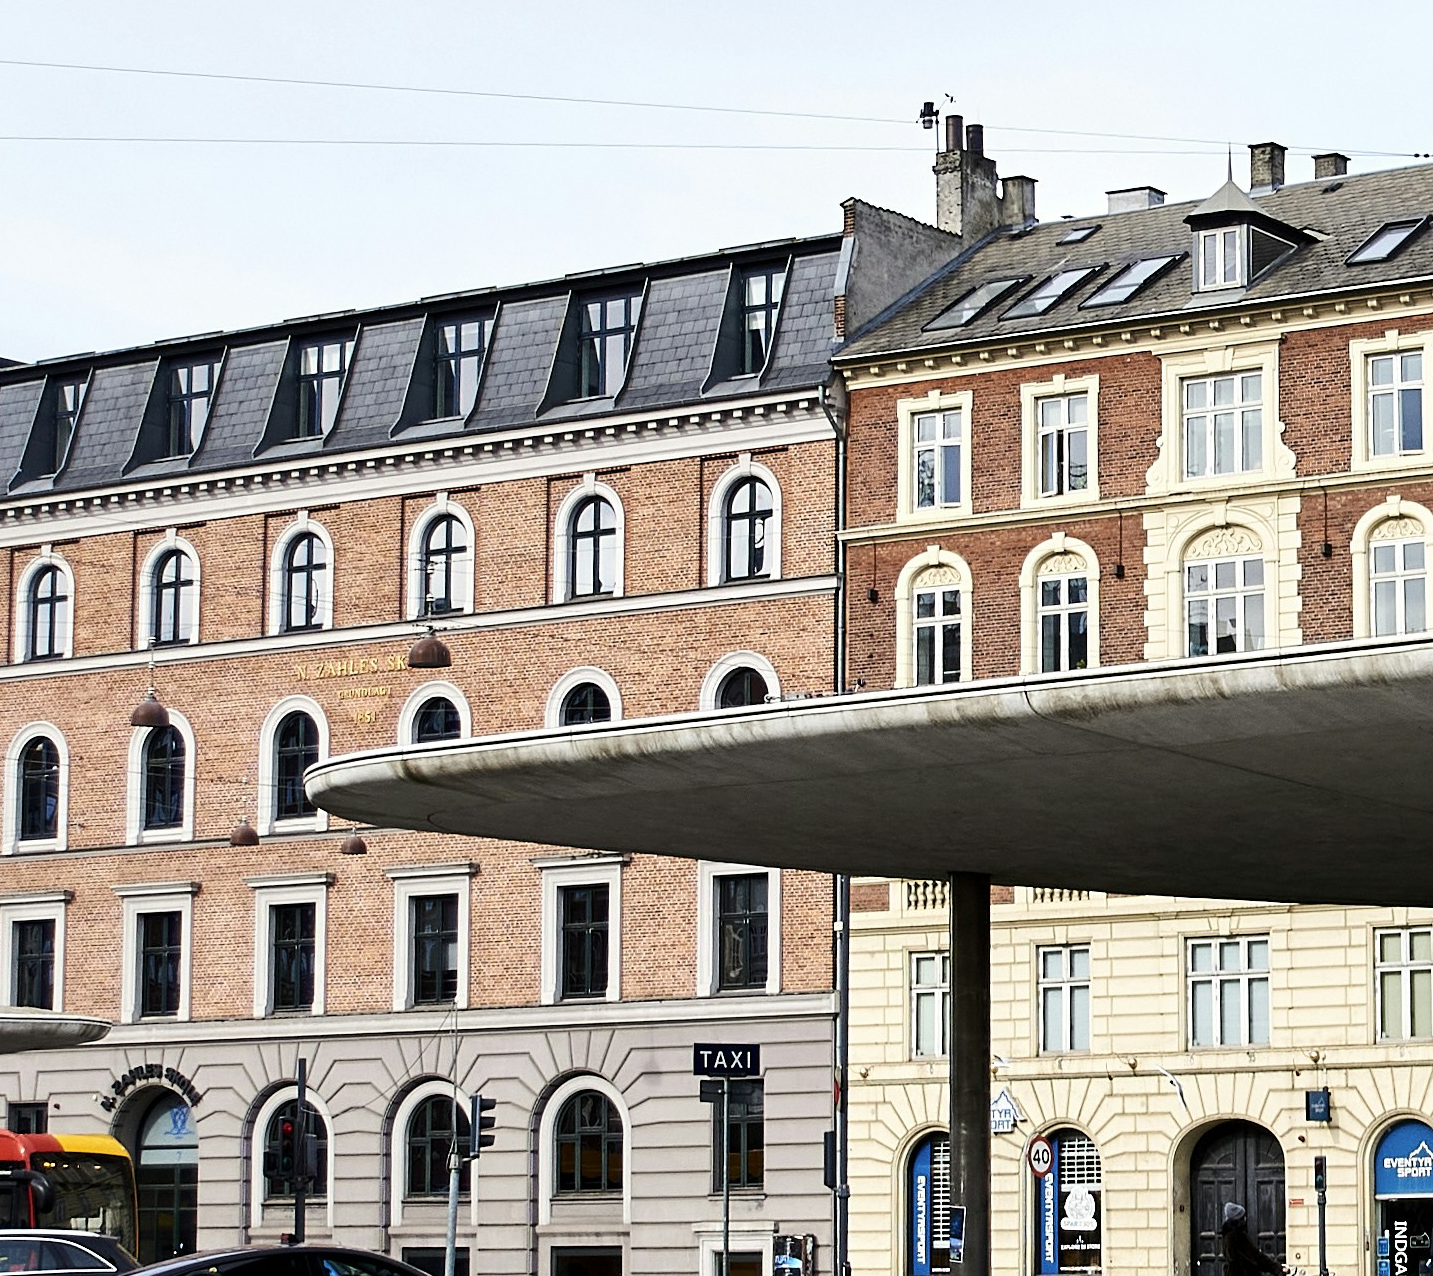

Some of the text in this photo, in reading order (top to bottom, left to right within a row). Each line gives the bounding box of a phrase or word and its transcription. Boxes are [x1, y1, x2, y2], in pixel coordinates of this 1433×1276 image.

[699, 1050, 752, 1069] TAXI
[1032, 1148, 1050, 1164] 40
[1383, 1157, 1433, 1169] EVENTYR
[1397, 1167, 1433, 1178] SPORT
